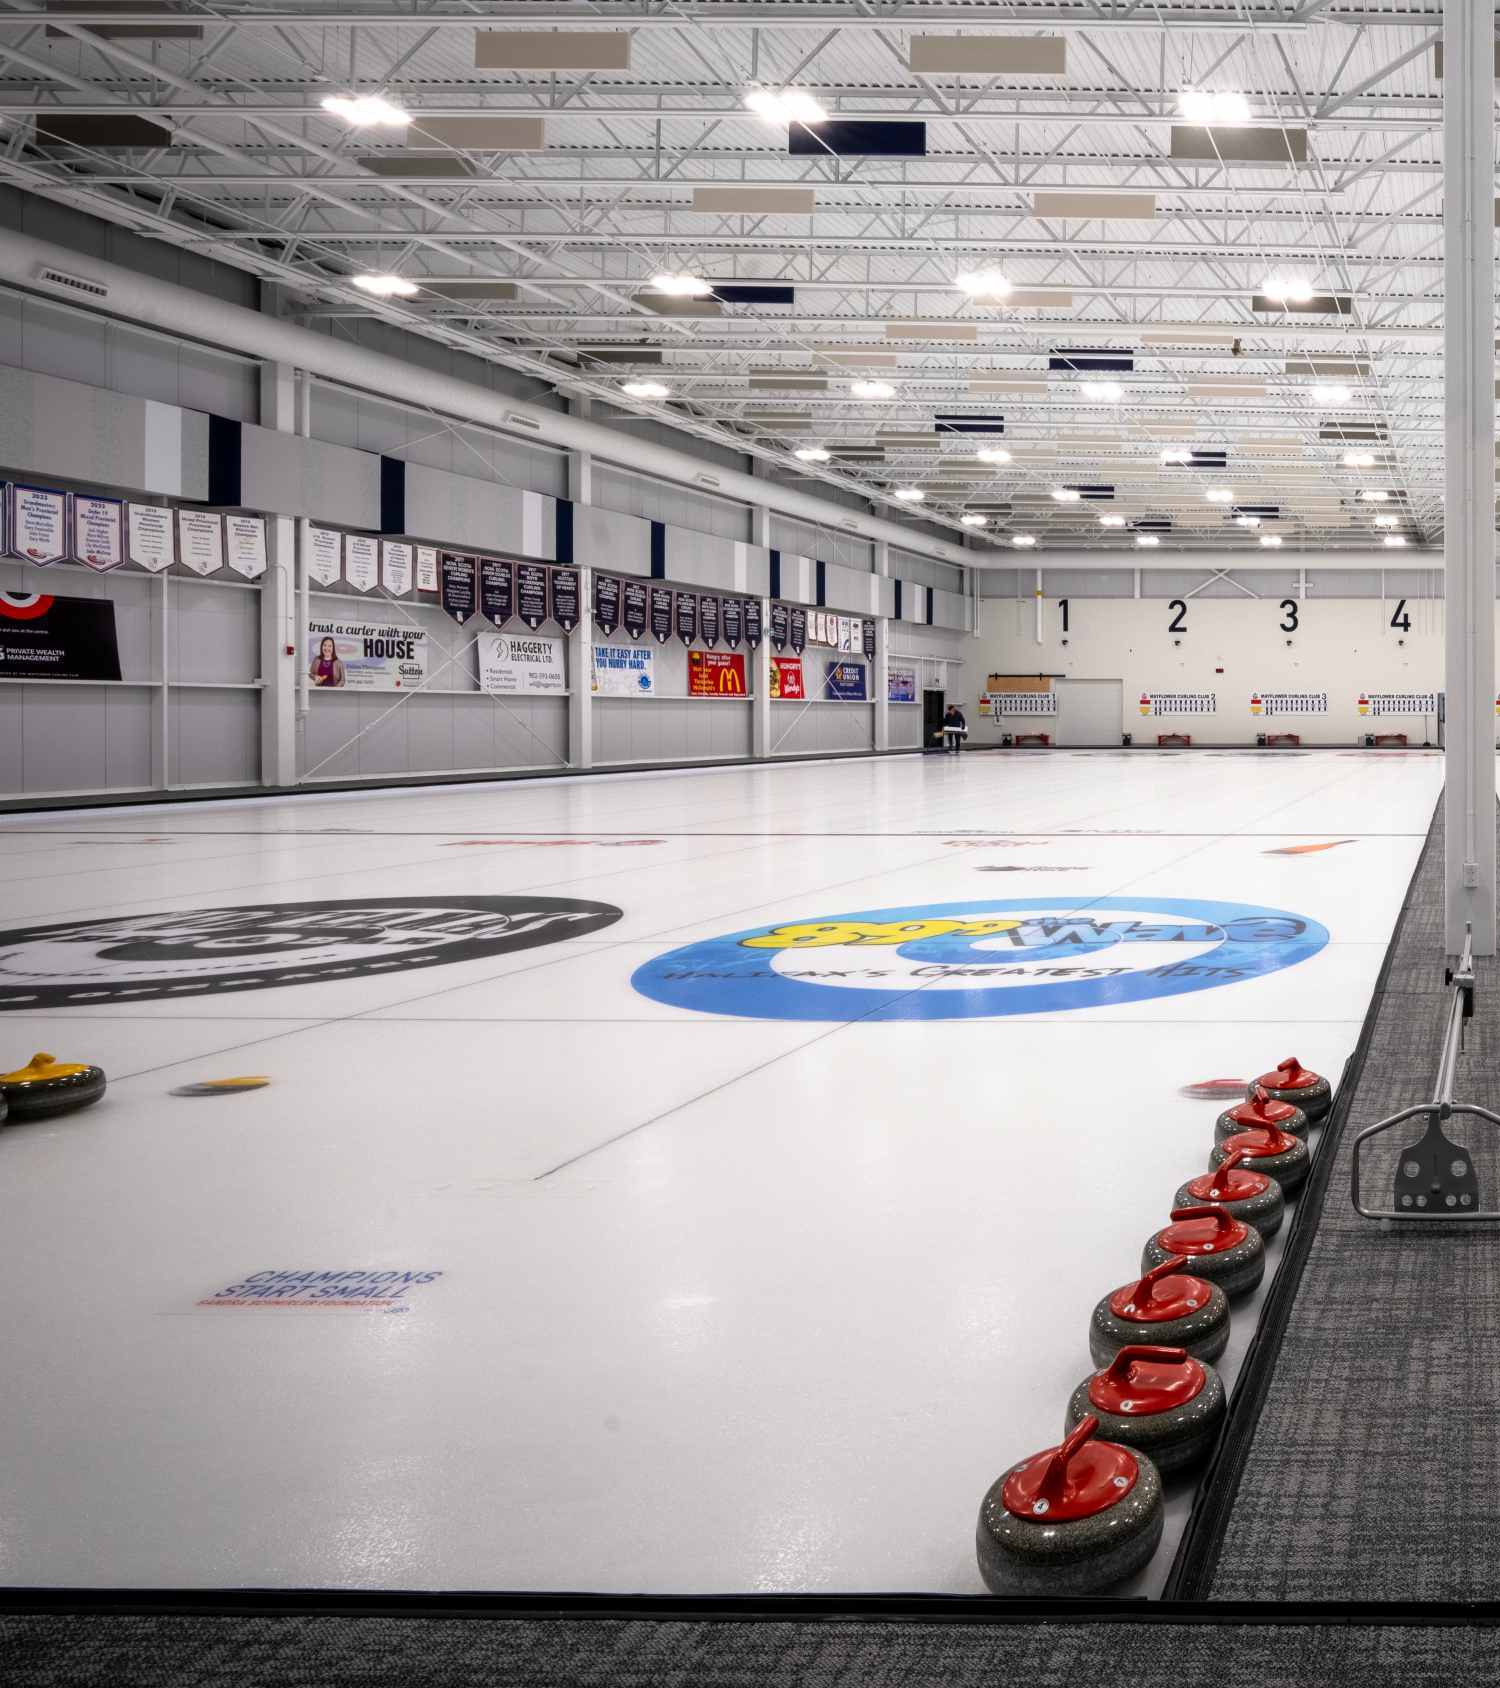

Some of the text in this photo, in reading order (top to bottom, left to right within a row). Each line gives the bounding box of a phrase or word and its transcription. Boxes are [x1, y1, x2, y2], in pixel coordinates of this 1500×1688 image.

[1058, 599, 1069, 632] 1
[1168, 600, 1187, 632] 2
[1280, 599, 1298, 632] 3
[1391, 599, 1411, 632] 4
[308, 621, 425, 641] trust a curler with your
[6, 647, 65, 657] PRIVATE WEALTH
[363, 638, 415, 659] HOUSE
[510, 641, 552, 654] HAGGERTY
[596, 647, 608, 657] TAKE
[617, 649, 631, 658] EASY
[633, 650, 651, 660] AFTER
[7, 654, 60, 662] MANAGEMENT
[511, 653, 542, 663] ELECTRICAL
[596, 658, 607, 668] YOU
[664, 963, 1257, 980] HALIFAX'S GREATEST HITS
[245, 1270, 442, 1284] CHAMPIONS
[215, 1284, 411, 1298] START SMALL
